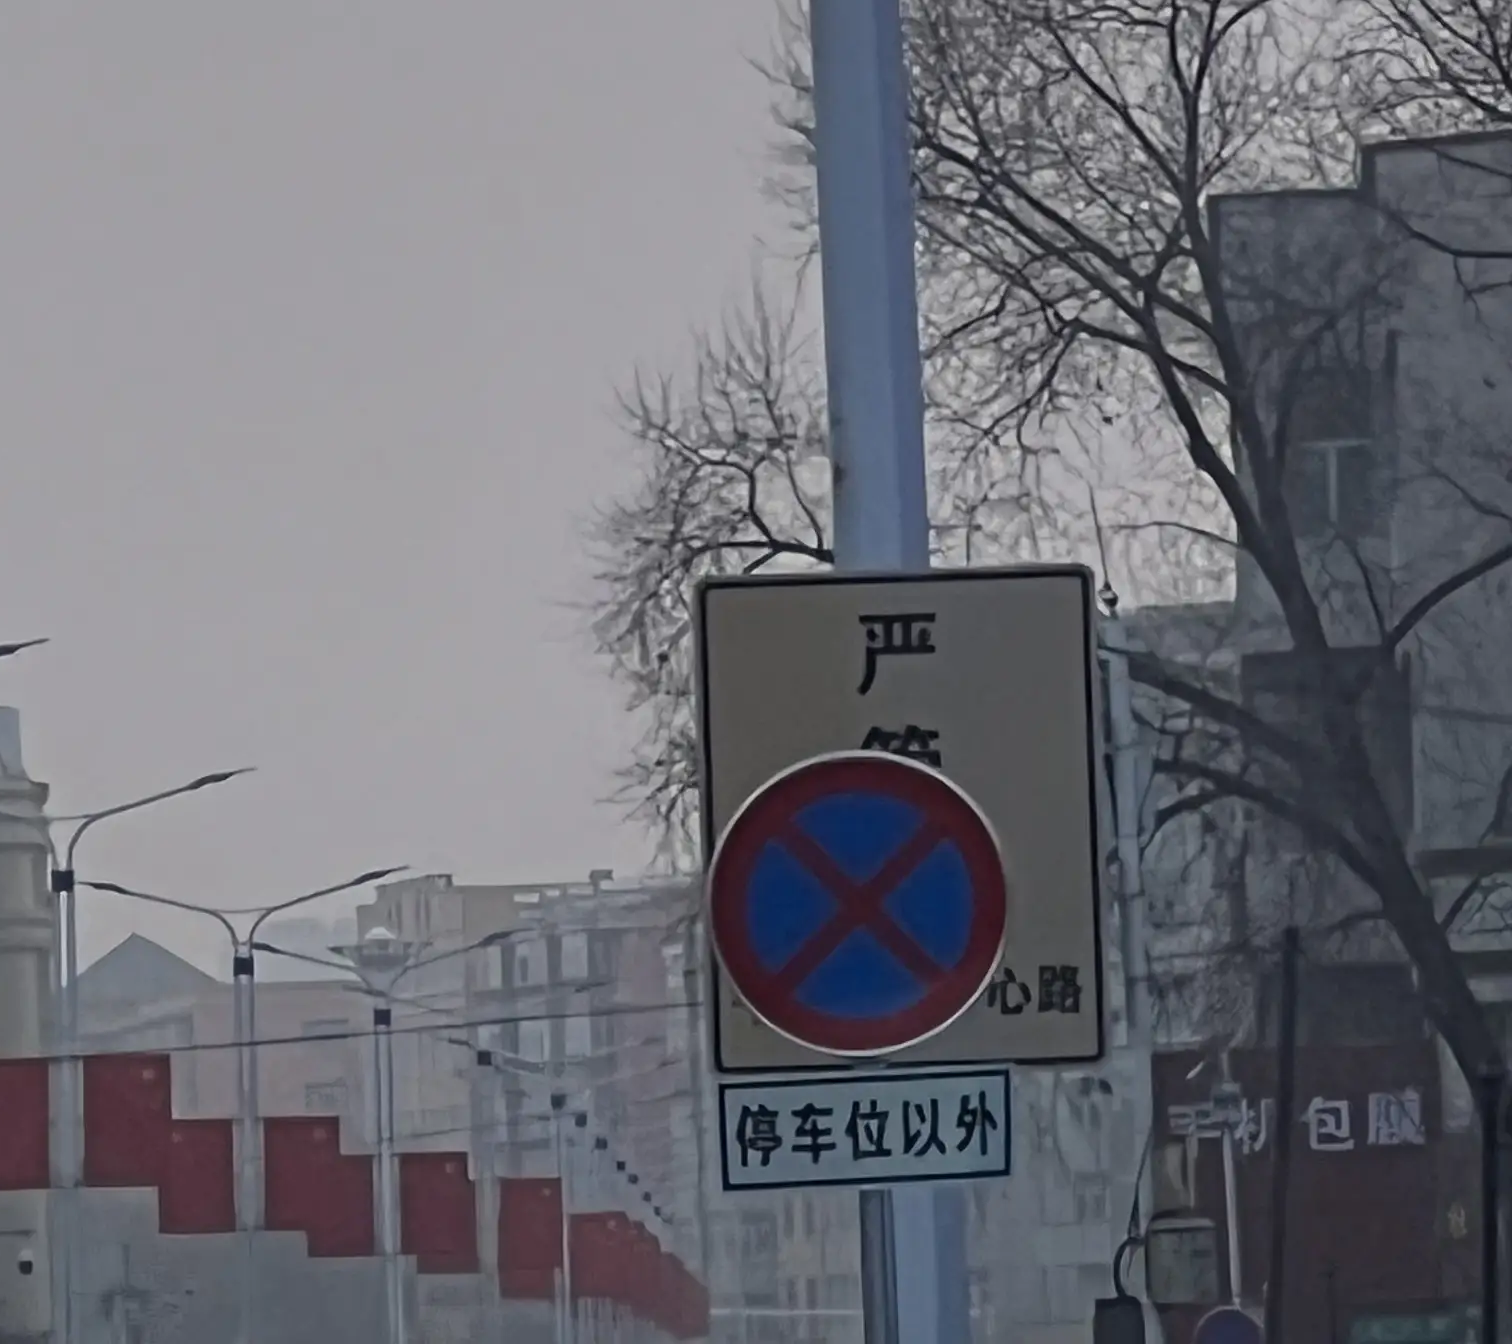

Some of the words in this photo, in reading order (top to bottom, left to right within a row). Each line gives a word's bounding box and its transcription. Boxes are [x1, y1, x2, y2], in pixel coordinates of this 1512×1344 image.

[735, 1091, 999, 1168] 停车位以外
